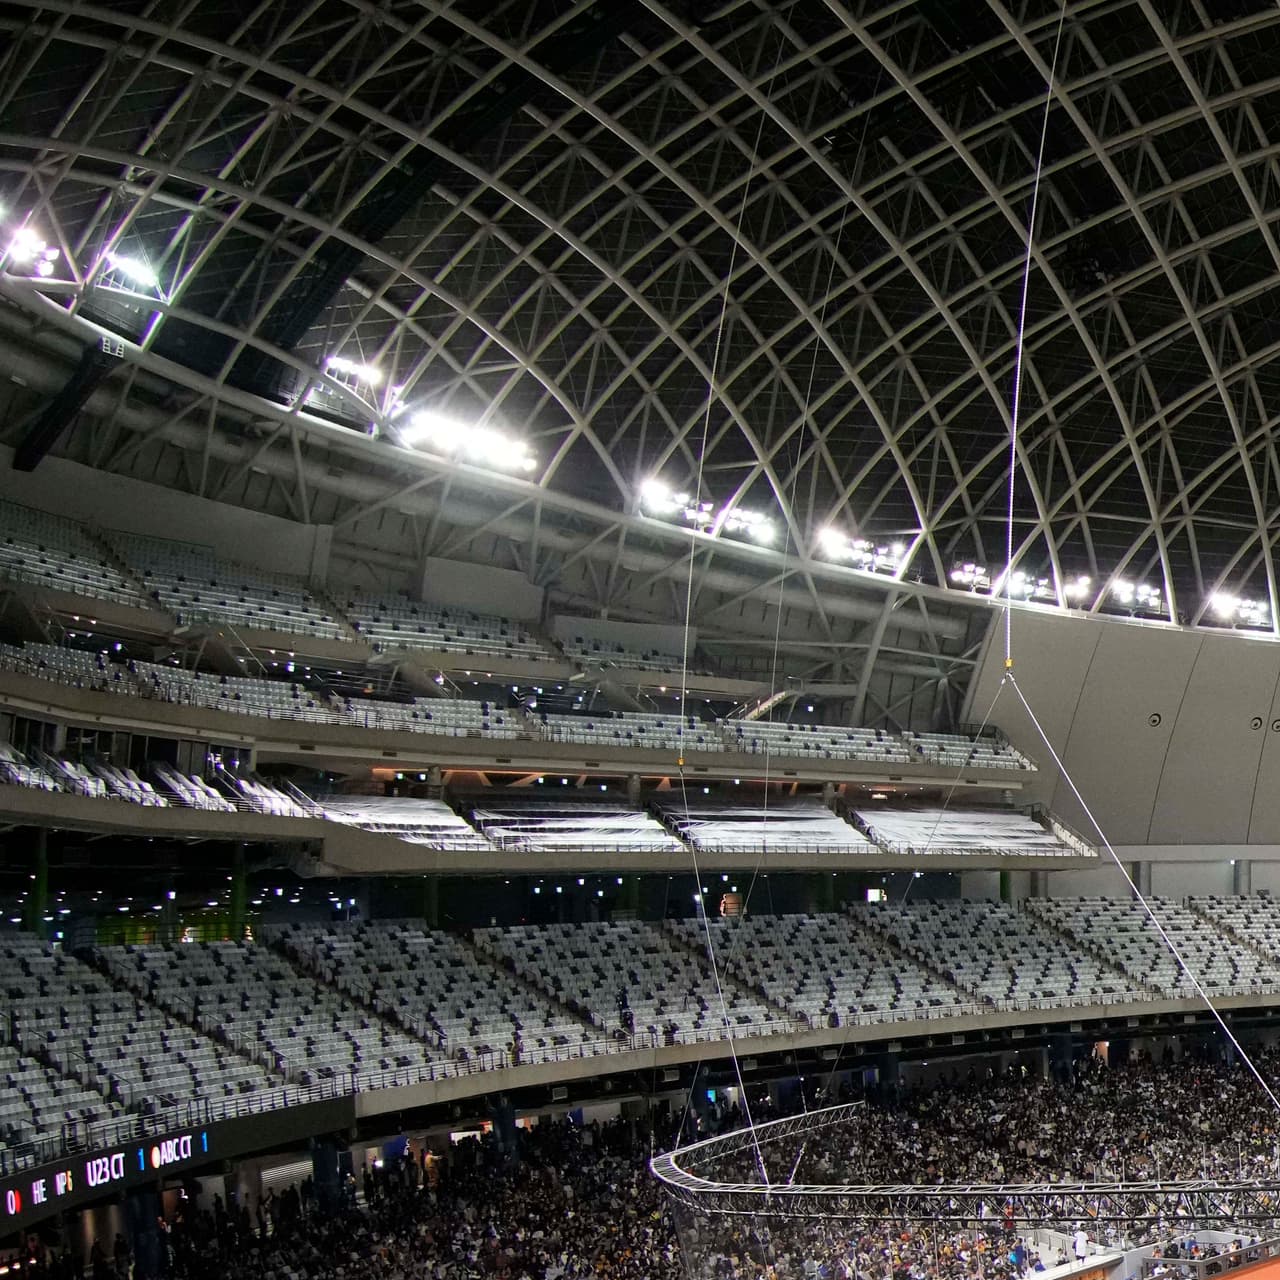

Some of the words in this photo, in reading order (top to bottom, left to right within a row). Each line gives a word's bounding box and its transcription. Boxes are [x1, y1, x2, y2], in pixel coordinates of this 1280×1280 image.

[86, 1158, 109, 1187] U23
[110, 1153, 125, 1180] CT
[138, 1148, 144, 1171] 1
[160, 1139, 180, 1165] ABC
[180, 1135, 192, 1158] CT
[201, 1131, 208, 1152] 1
